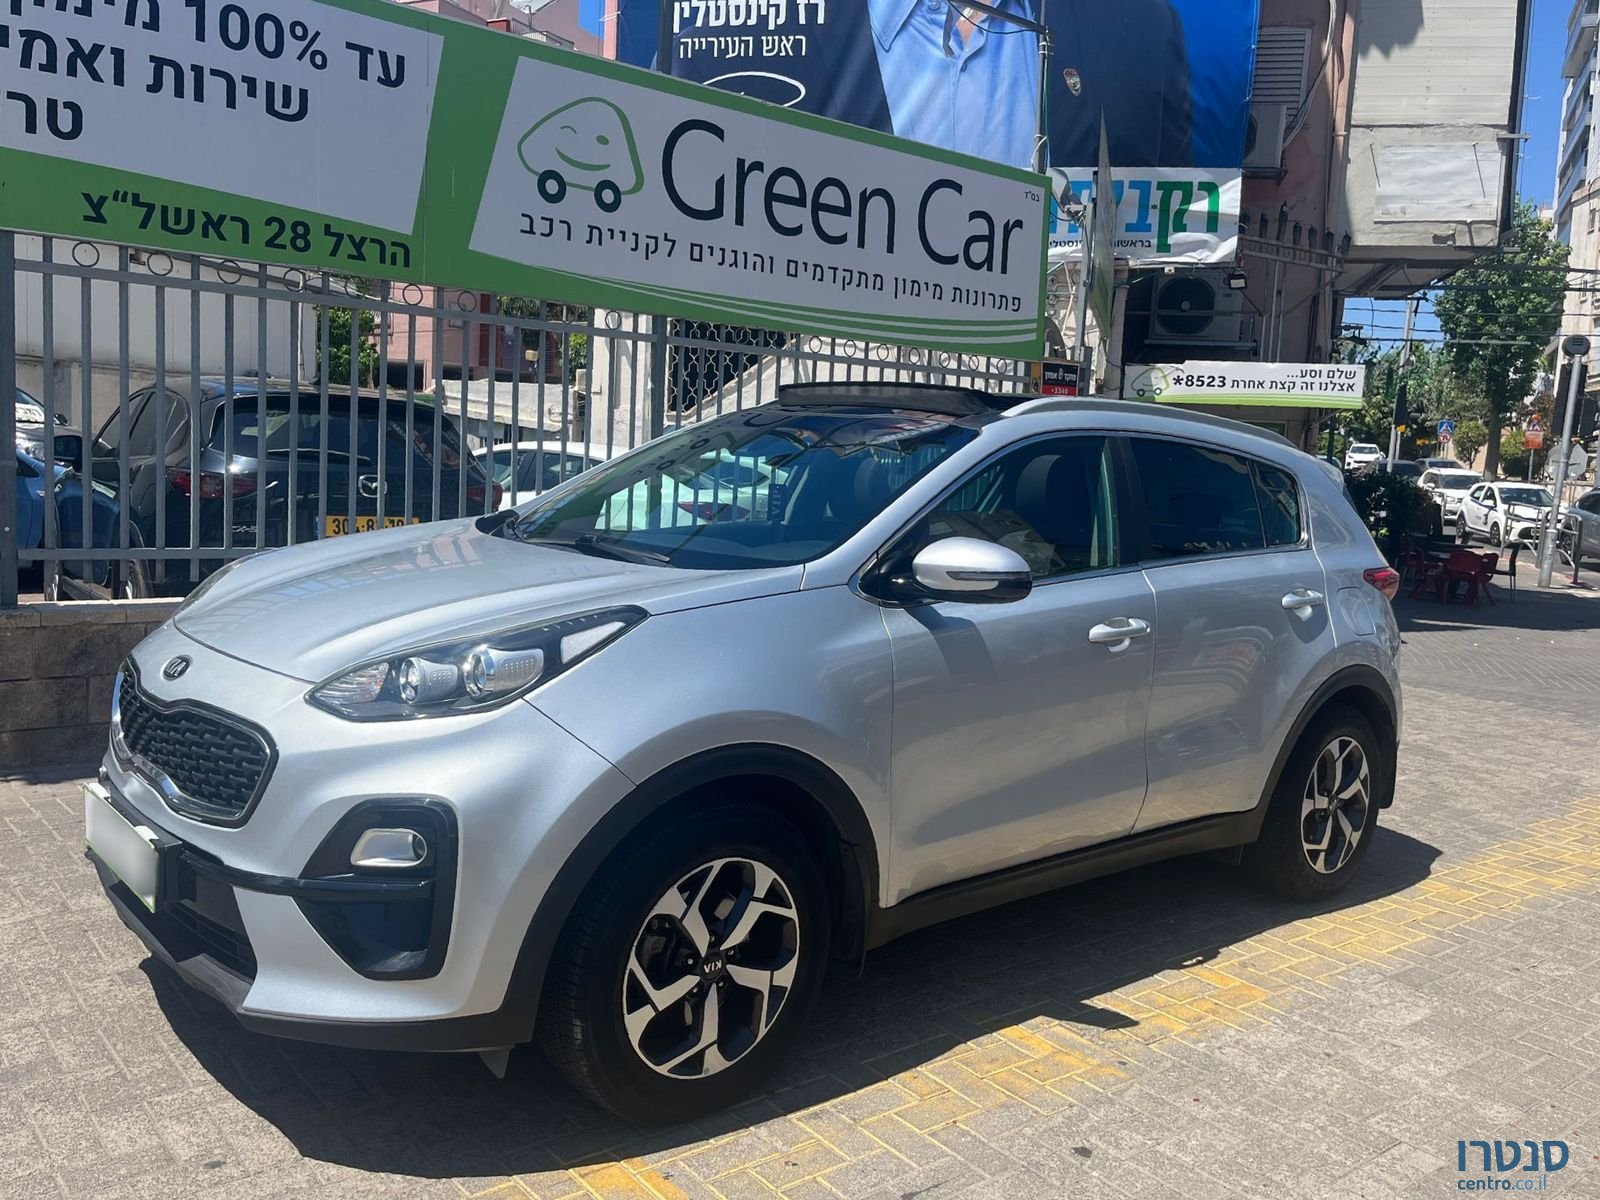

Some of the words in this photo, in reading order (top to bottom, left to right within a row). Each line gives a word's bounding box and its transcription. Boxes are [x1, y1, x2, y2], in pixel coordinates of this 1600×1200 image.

[184, 0, 328, 70] 100%
[679, 36, 753, 59] העירייה
[761, 35, 806, 57] ראש
[345, 41, 405, 88] עד
[146, 54, 309, 122] שירות
[661, 119, 896, 254] Green
[917, 178, 1024, 275] Car
[264, 216, 312, 253] 28
[520, 212, 572, 241] רכב
[323, 223, 411, 268] הרצל
[585, 224, 677, 260] לקניית
[689, 242, 774, 274] והוגנים
[786, 258, 884, 291] מתקדמים
[894, 276, 943, 300] מימון
[951, 286, 1021, 312] פתרונות
[1230, 378, 1265, 390] אחרת
[1269, 379, 1296, 393] קצת
[1300, 380, 1315, 391] זה
[1318, 380, 1356, 392] אצלנו
[1326, 368, 1357, 380] שלם
